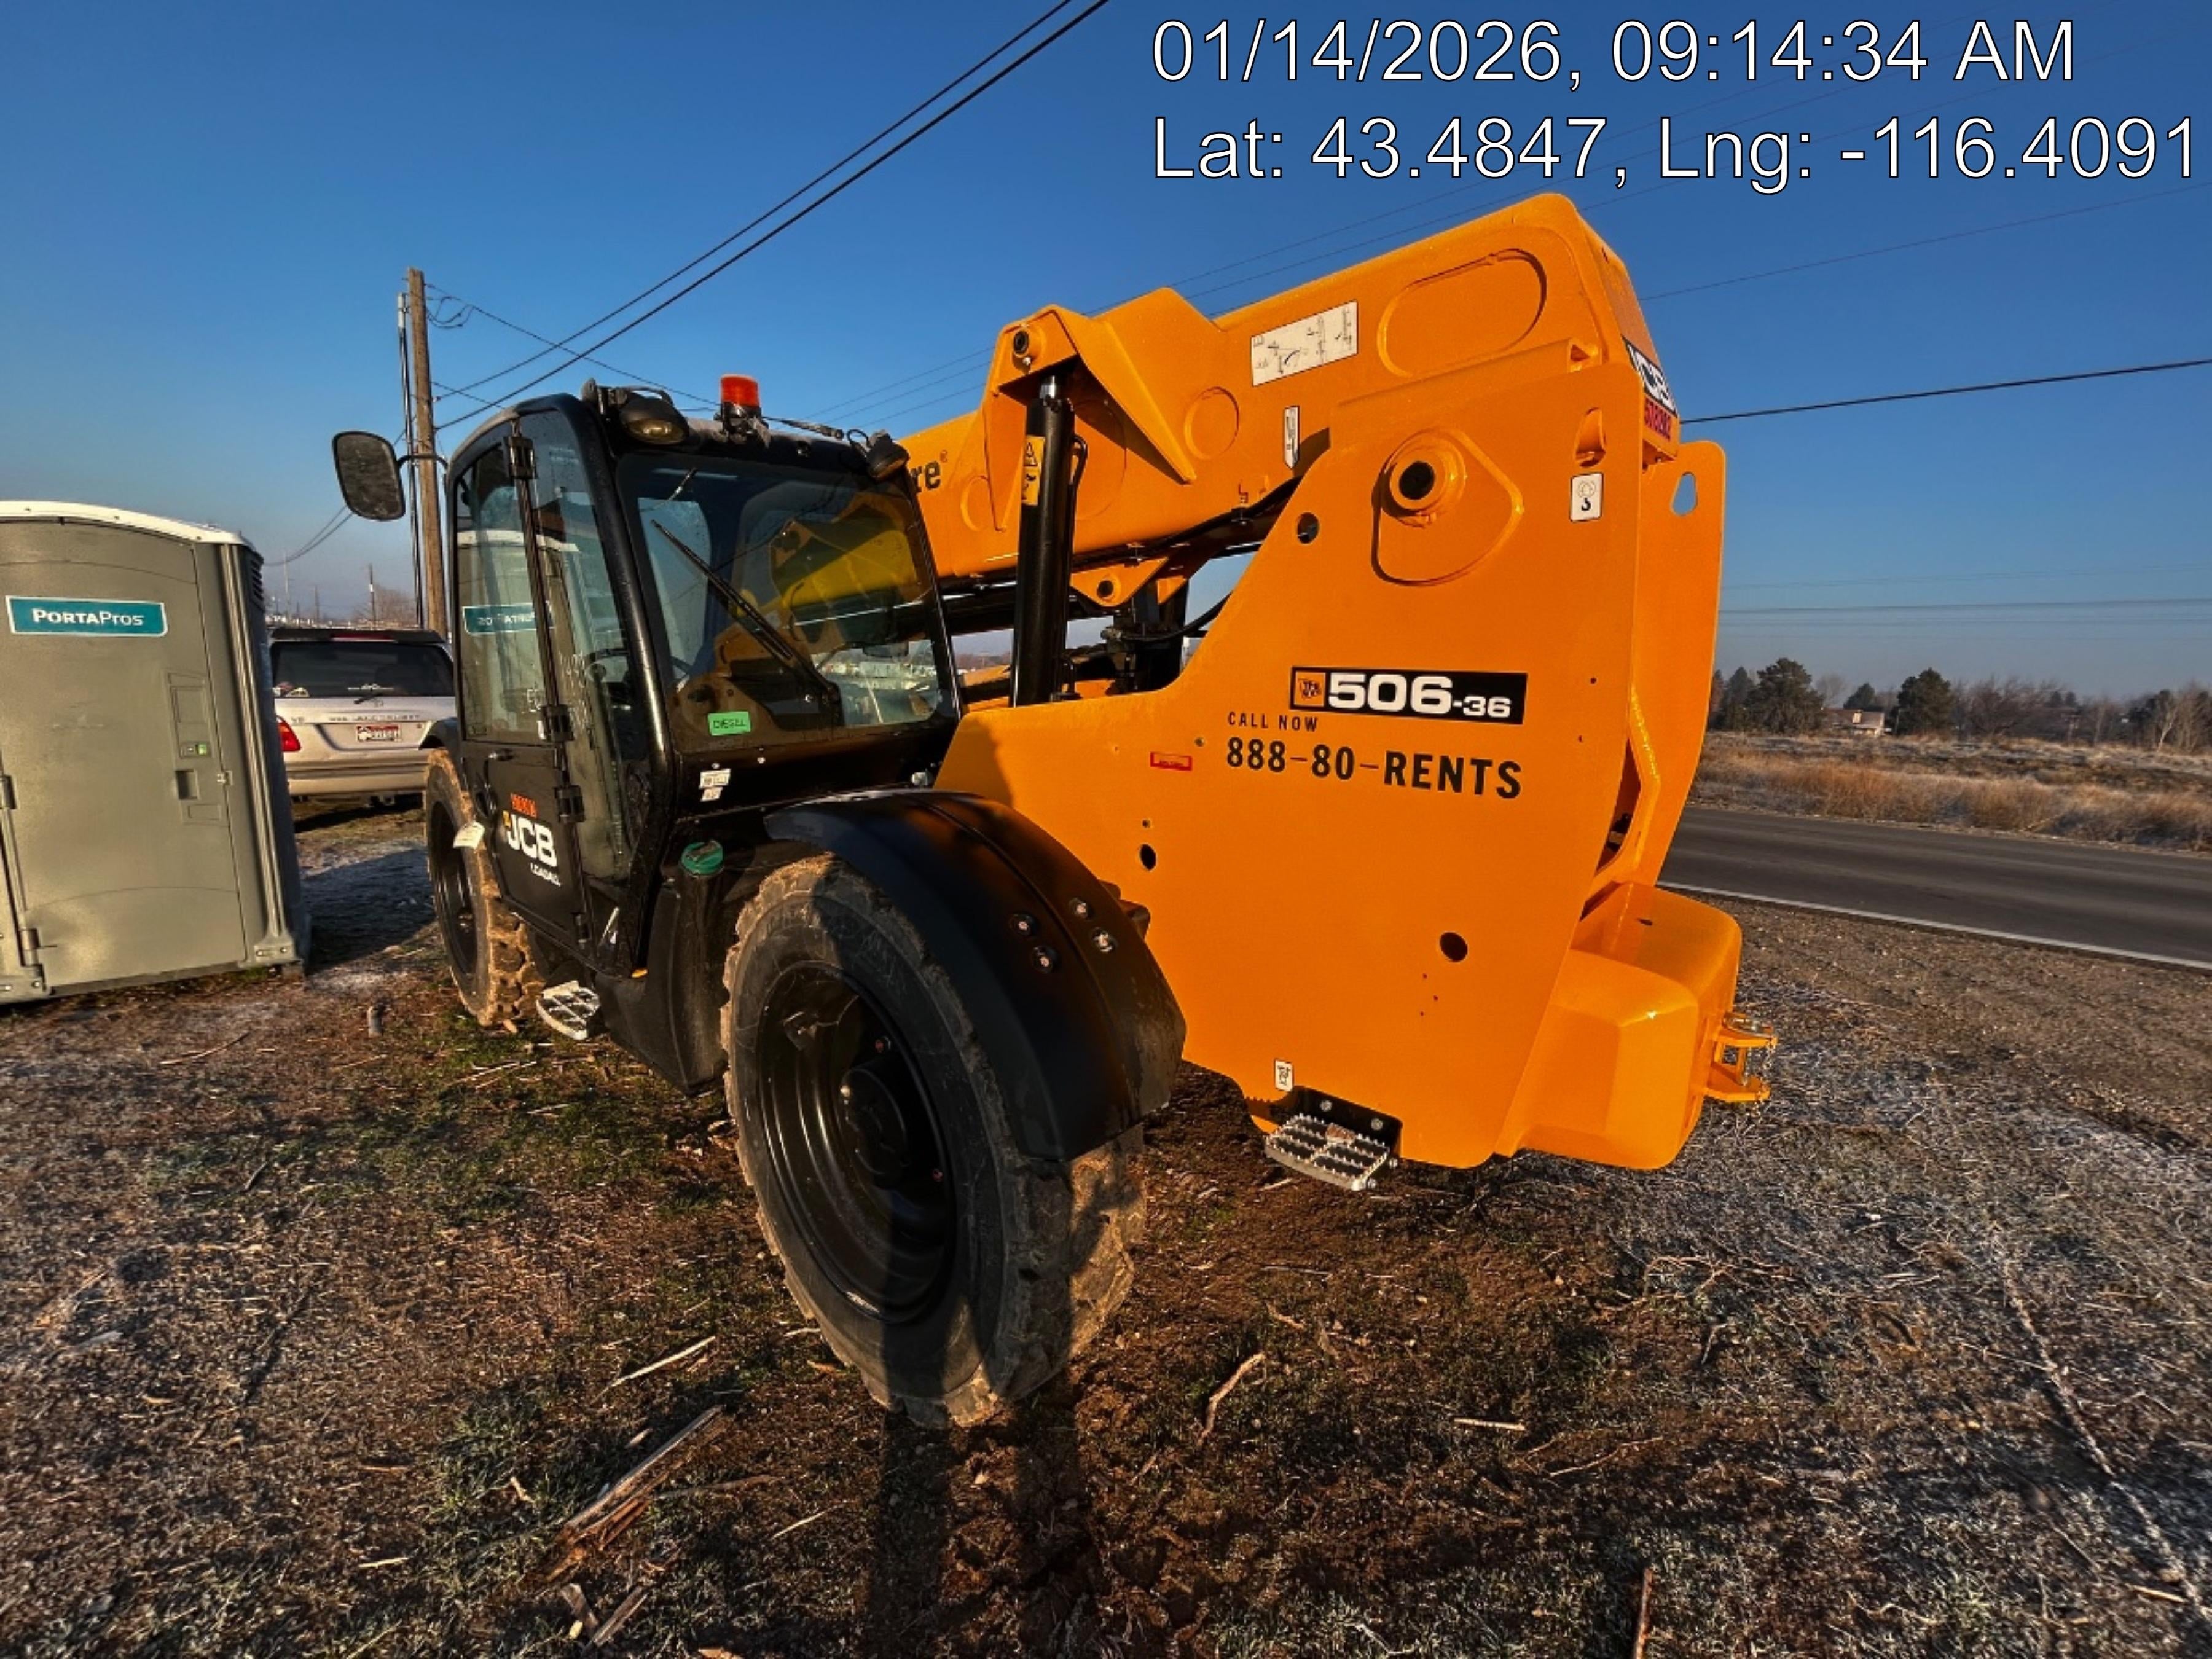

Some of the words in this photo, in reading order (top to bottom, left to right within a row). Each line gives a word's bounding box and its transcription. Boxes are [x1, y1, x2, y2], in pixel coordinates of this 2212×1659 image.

[1328, 672, 1512, 718] 506-36
[1228, 711, 1268, 729] CALL
[1278, 715, 1319, 732] NOW
[506, 814, 557, 868] JCB
